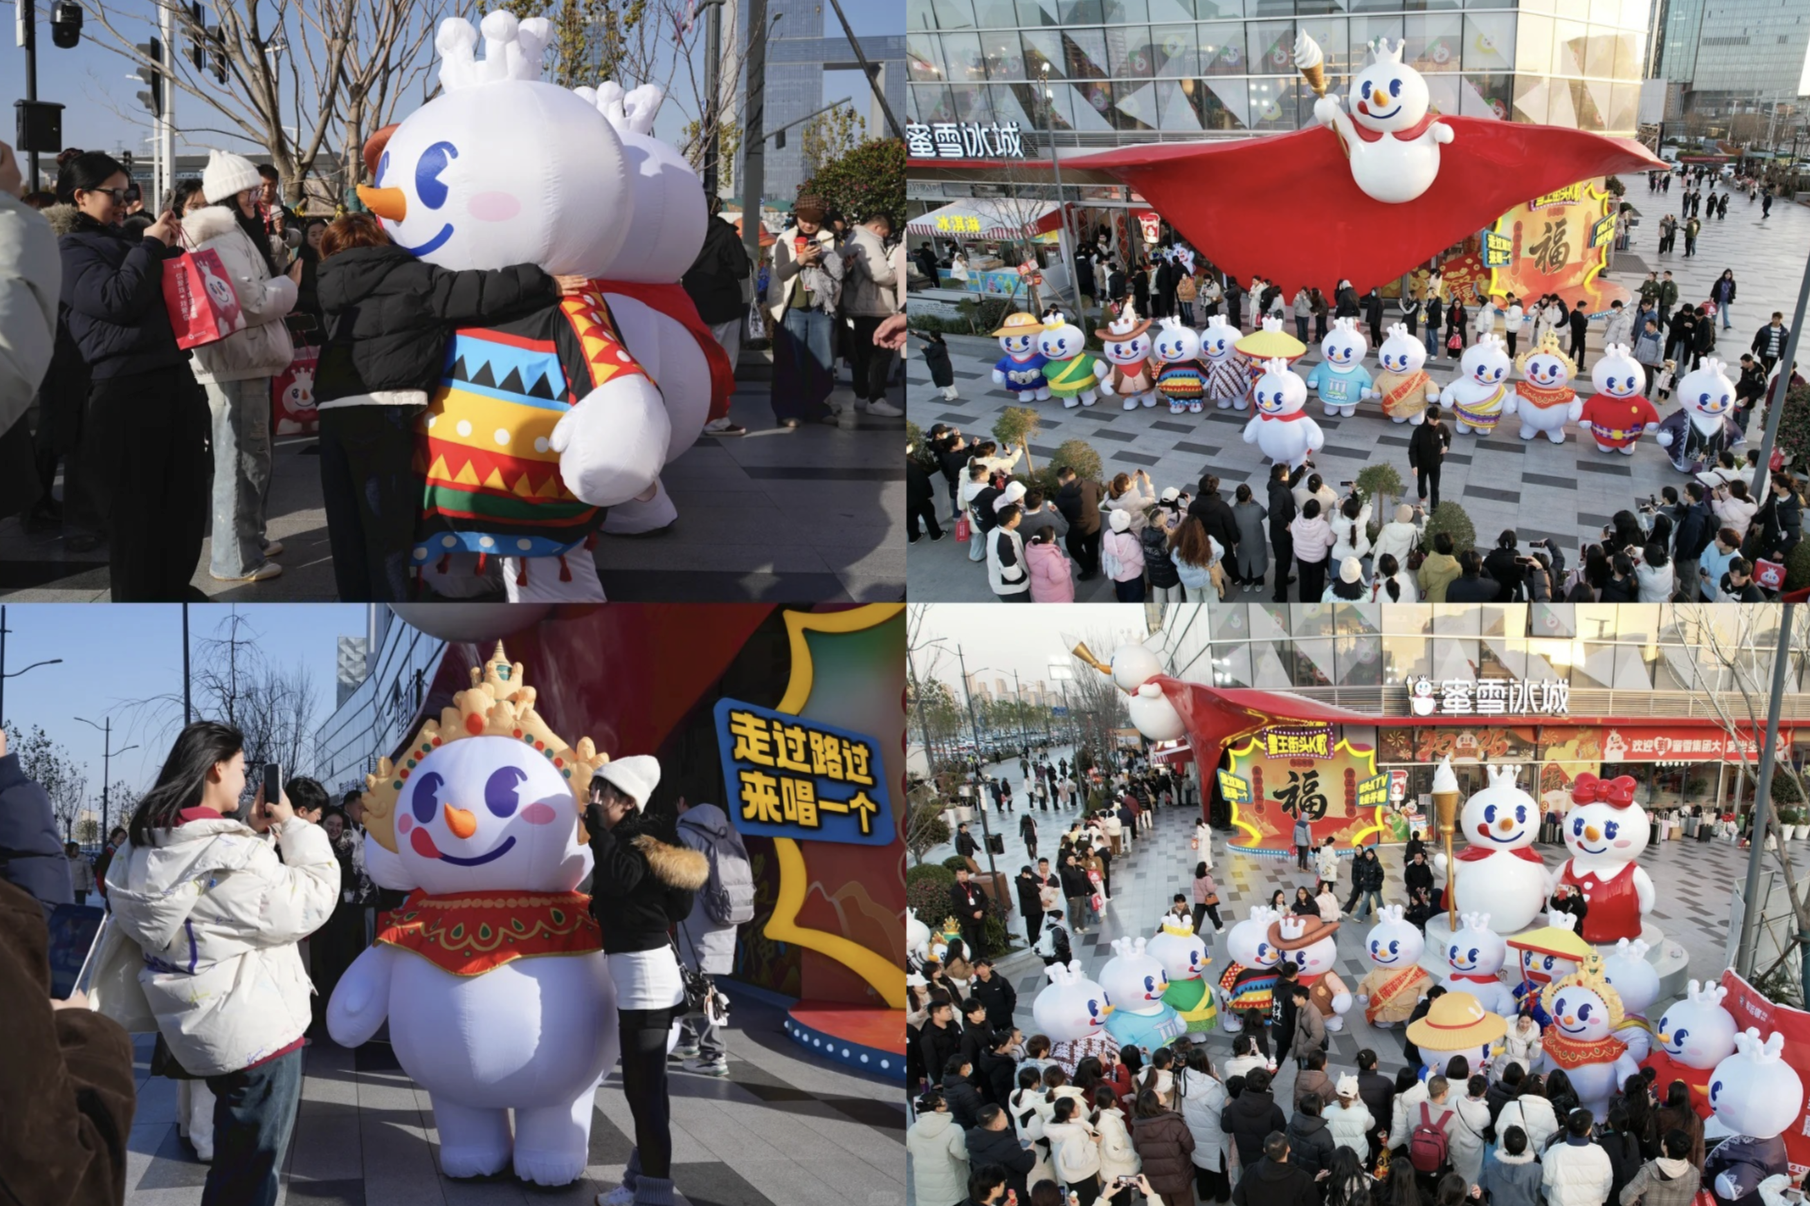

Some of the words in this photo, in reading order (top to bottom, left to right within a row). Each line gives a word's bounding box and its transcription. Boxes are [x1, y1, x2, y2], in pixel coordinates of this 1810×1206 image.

[906, 121, 1024, 157] 蜜雪冰城
[935, 215, 981, 233] 冰淇淋
[1529, 218, 1571, 275] 福
[1441, 678, 1569, 714] 蜜雪冰城
[731, 711, 873, 785] 走过路过
[740, 771, 877, 833] 来唱一个
[1272, 769, 1328, 821] 福
